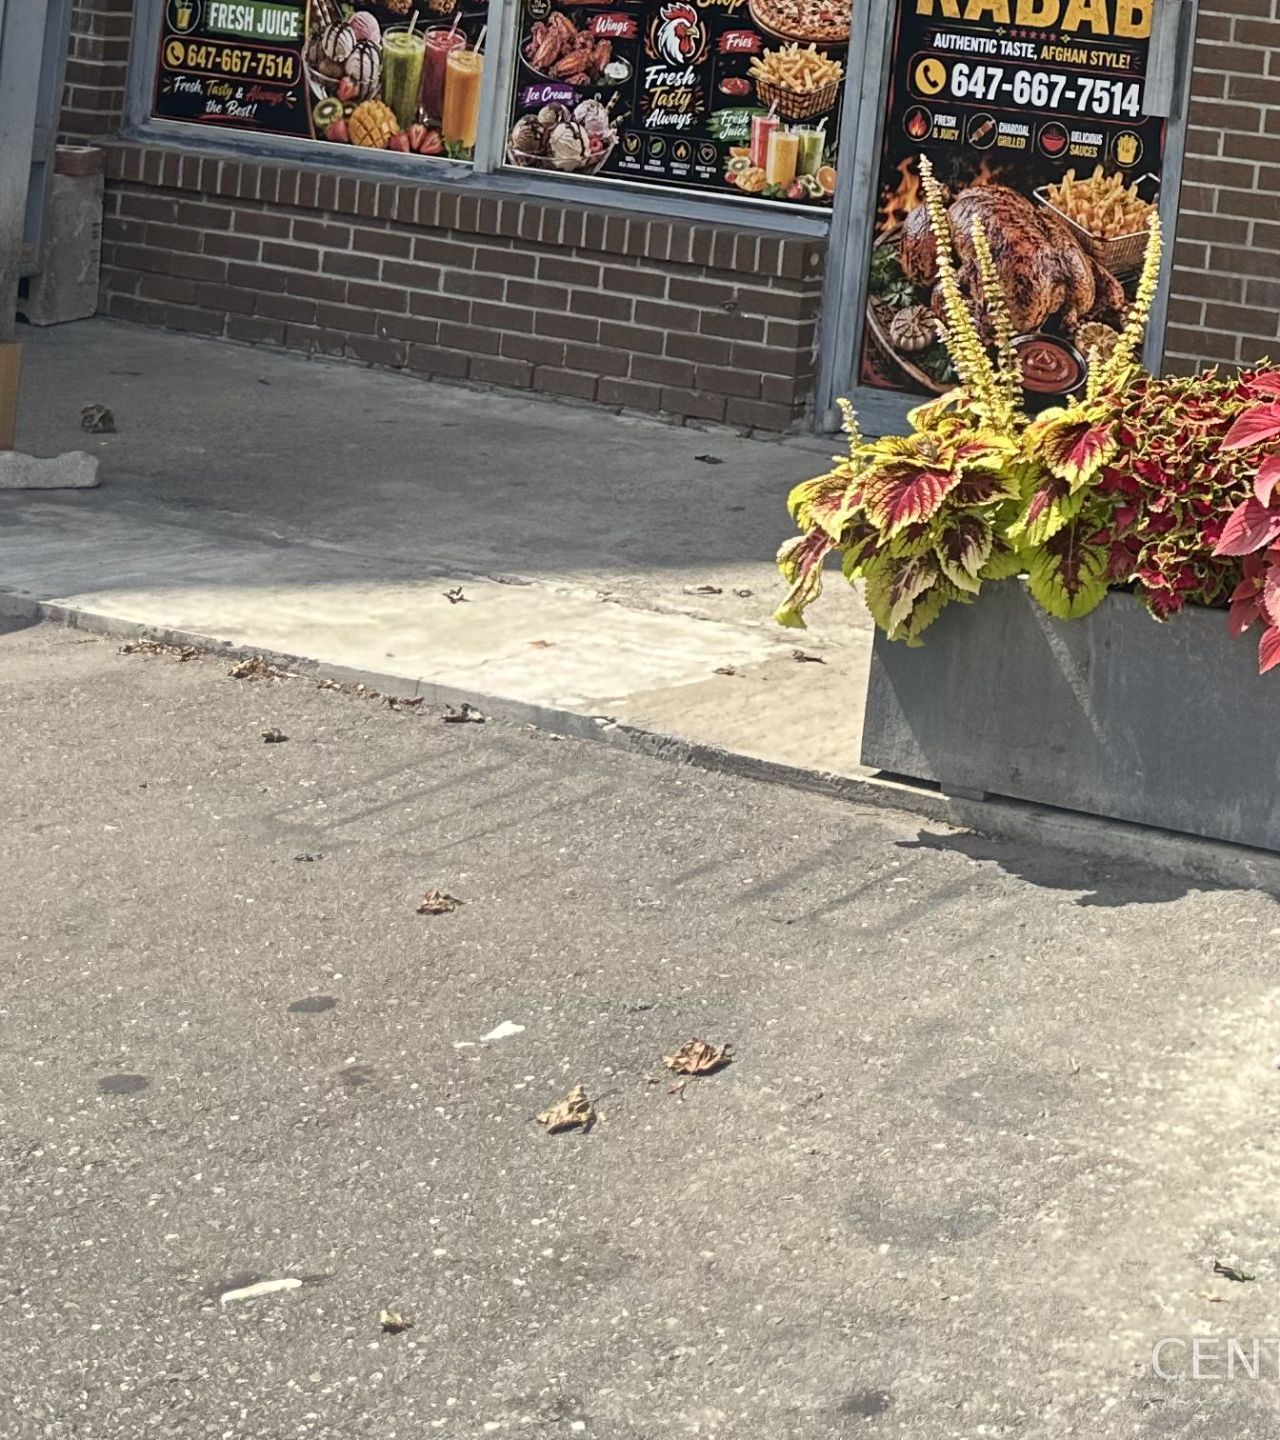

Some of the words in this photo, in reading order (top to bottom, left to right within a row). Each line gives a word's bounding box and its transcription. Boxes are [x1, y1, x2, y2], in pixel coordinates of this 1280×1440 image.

[209, 2, 255, 32] FRESH
[257, 8, 299, 37] JUICE
[595, 17, 629, 36] Wings
[725, 33, 754, 50] Fries
[933, 32, 998, 54] AUTHENTIC
[999, 39, 1038, 61] TASTE,
[1040, 45, 1088, 65] AFGHAN
[1089, 51, 1132, 69] STYLE!
[187, 44, 294, 79] 647-667-7514
[644, 64, 697, 89] Fresh
[206, 79, 233, 101] Tasty
[235, 87, 244, 99] &
[525, 87, 540, 103] Ice
[541, 87, 572, 101] Cream
[649, 85, 693, 112] Tasty
[951, 62, 1141, 118] 647-667-7514
[205, 100, 223, 114] the
[226, 100, 258, 118] Best!
[720, 110, 750, 125] Fresh
[645, 109, 693, 130] Always
[933, 113, 957, 127] FRESH
[719, 123, 749, 140] Juice
[939, 128, 960, 141] JUICY
[1069, 144, 1098, 158] SAUCES
